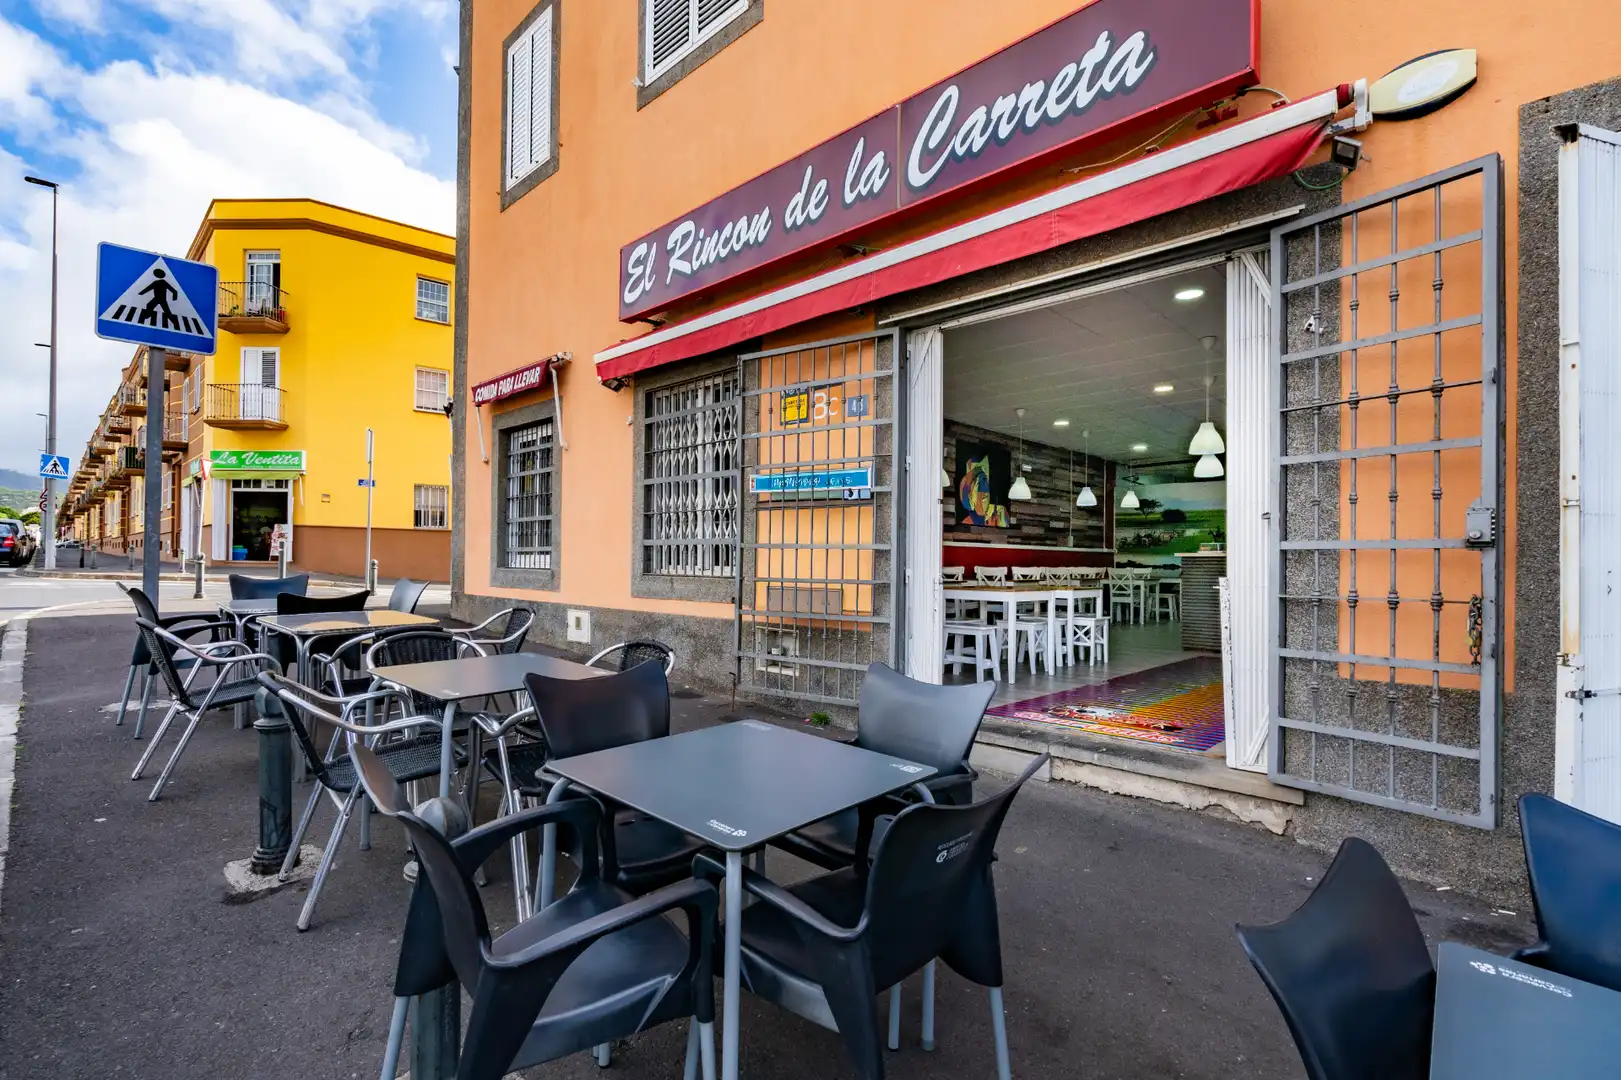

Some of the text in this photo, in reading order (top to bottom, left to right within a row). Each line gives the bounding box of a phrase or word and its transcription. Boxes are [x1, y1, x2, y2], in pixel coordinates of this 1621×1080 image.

[623, 29, 1155, 304] El Rincon de la Carreta
[475, 366, 541, 402] COMIDA PARA LLEVAR
[213, 451, 301, 465] La Ventita
